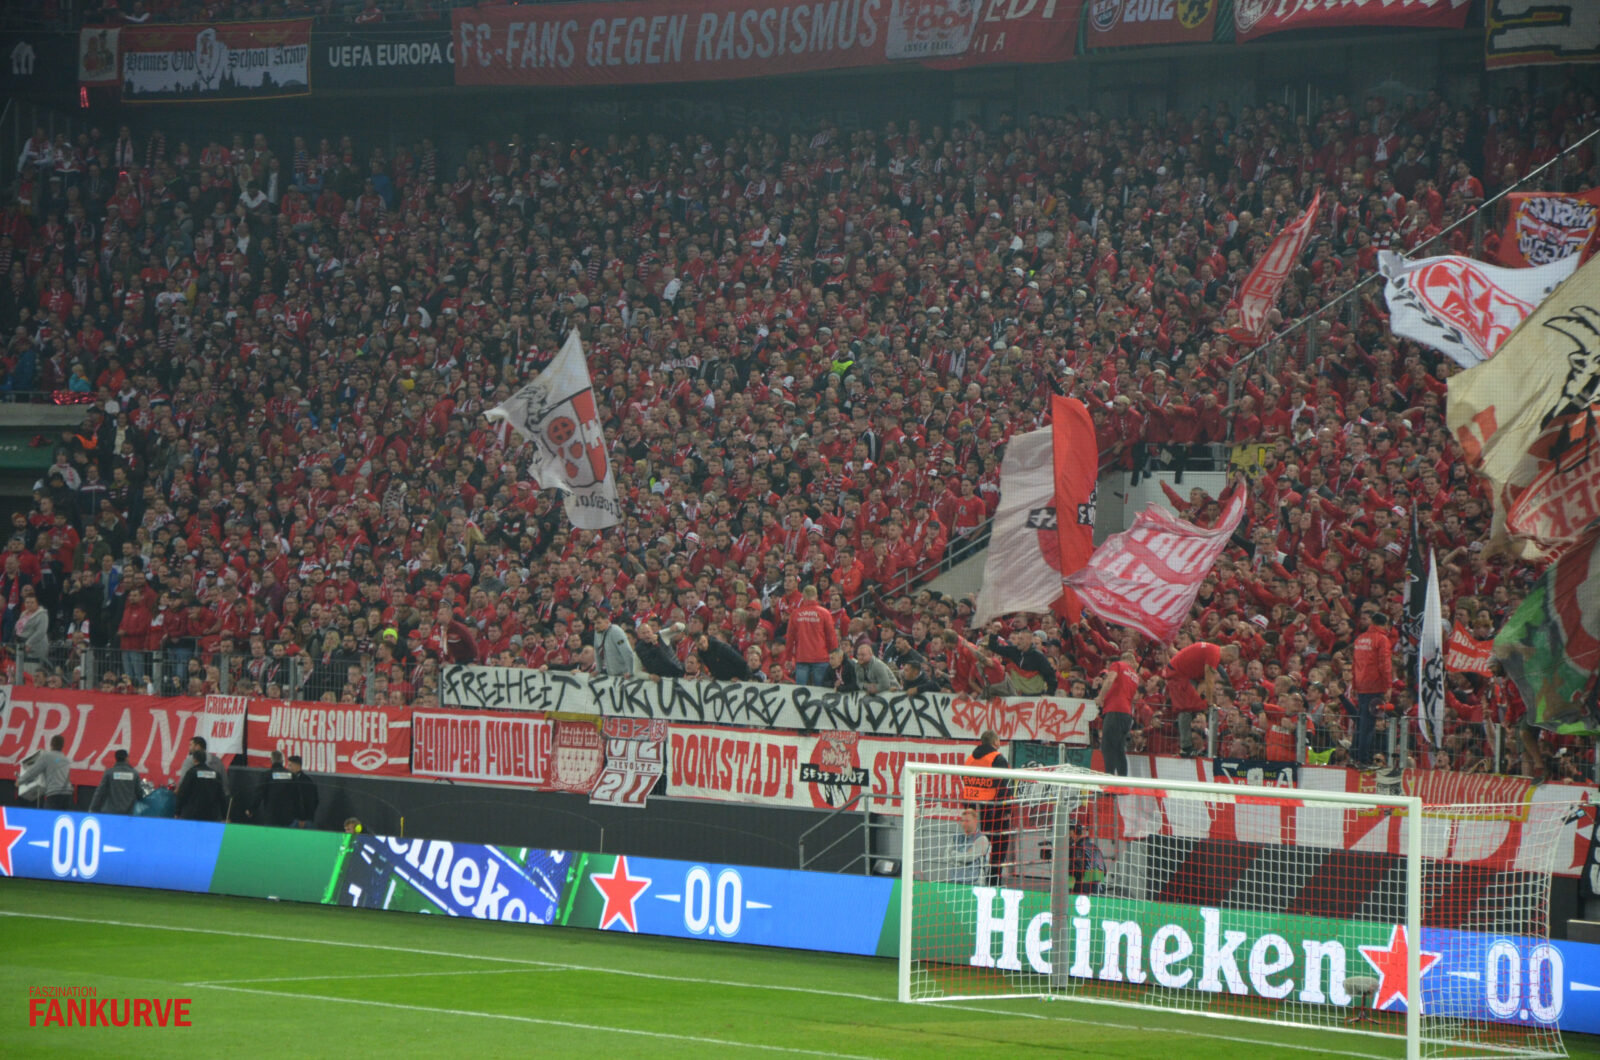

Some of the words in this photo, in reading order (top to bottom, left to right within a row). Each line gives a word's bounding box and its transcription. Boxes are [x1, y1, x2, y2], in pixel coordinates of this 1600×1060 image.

[171, 50, 195, 73] Old
[227, 48, 269, 69] School
[328, 46, 373, 68] UEFA
[376, 43, 441, 66] EUROPA
[460, 20, 579, 69] FC-FANS
[587, 14, 689, 67] GEGEN
[695, 0, 882, 61] RASSISMUS
[210, 719, 233, 739] KÖLN
[266, 704, 388, 743] MÜNGERSDORFER
[588, 676, 653, 719] FÜR
[655, 675, 788, 728] UNSERE
[0, 700, 213, 777] ERLAN
[277, 740, 337, 774] STADION
[413, 716, 480, 772] SEMPER
[484, 720, 551, 779] FIDELIS
[671, 733, 799, 800] DOMSTADT
[49, 815, 102, 879] 0.0
[683, 865, 742, 940] 0.0
[970, 885, 1347, 1006] Heineken
[1486, 939, 1564, 1024] 0.0
